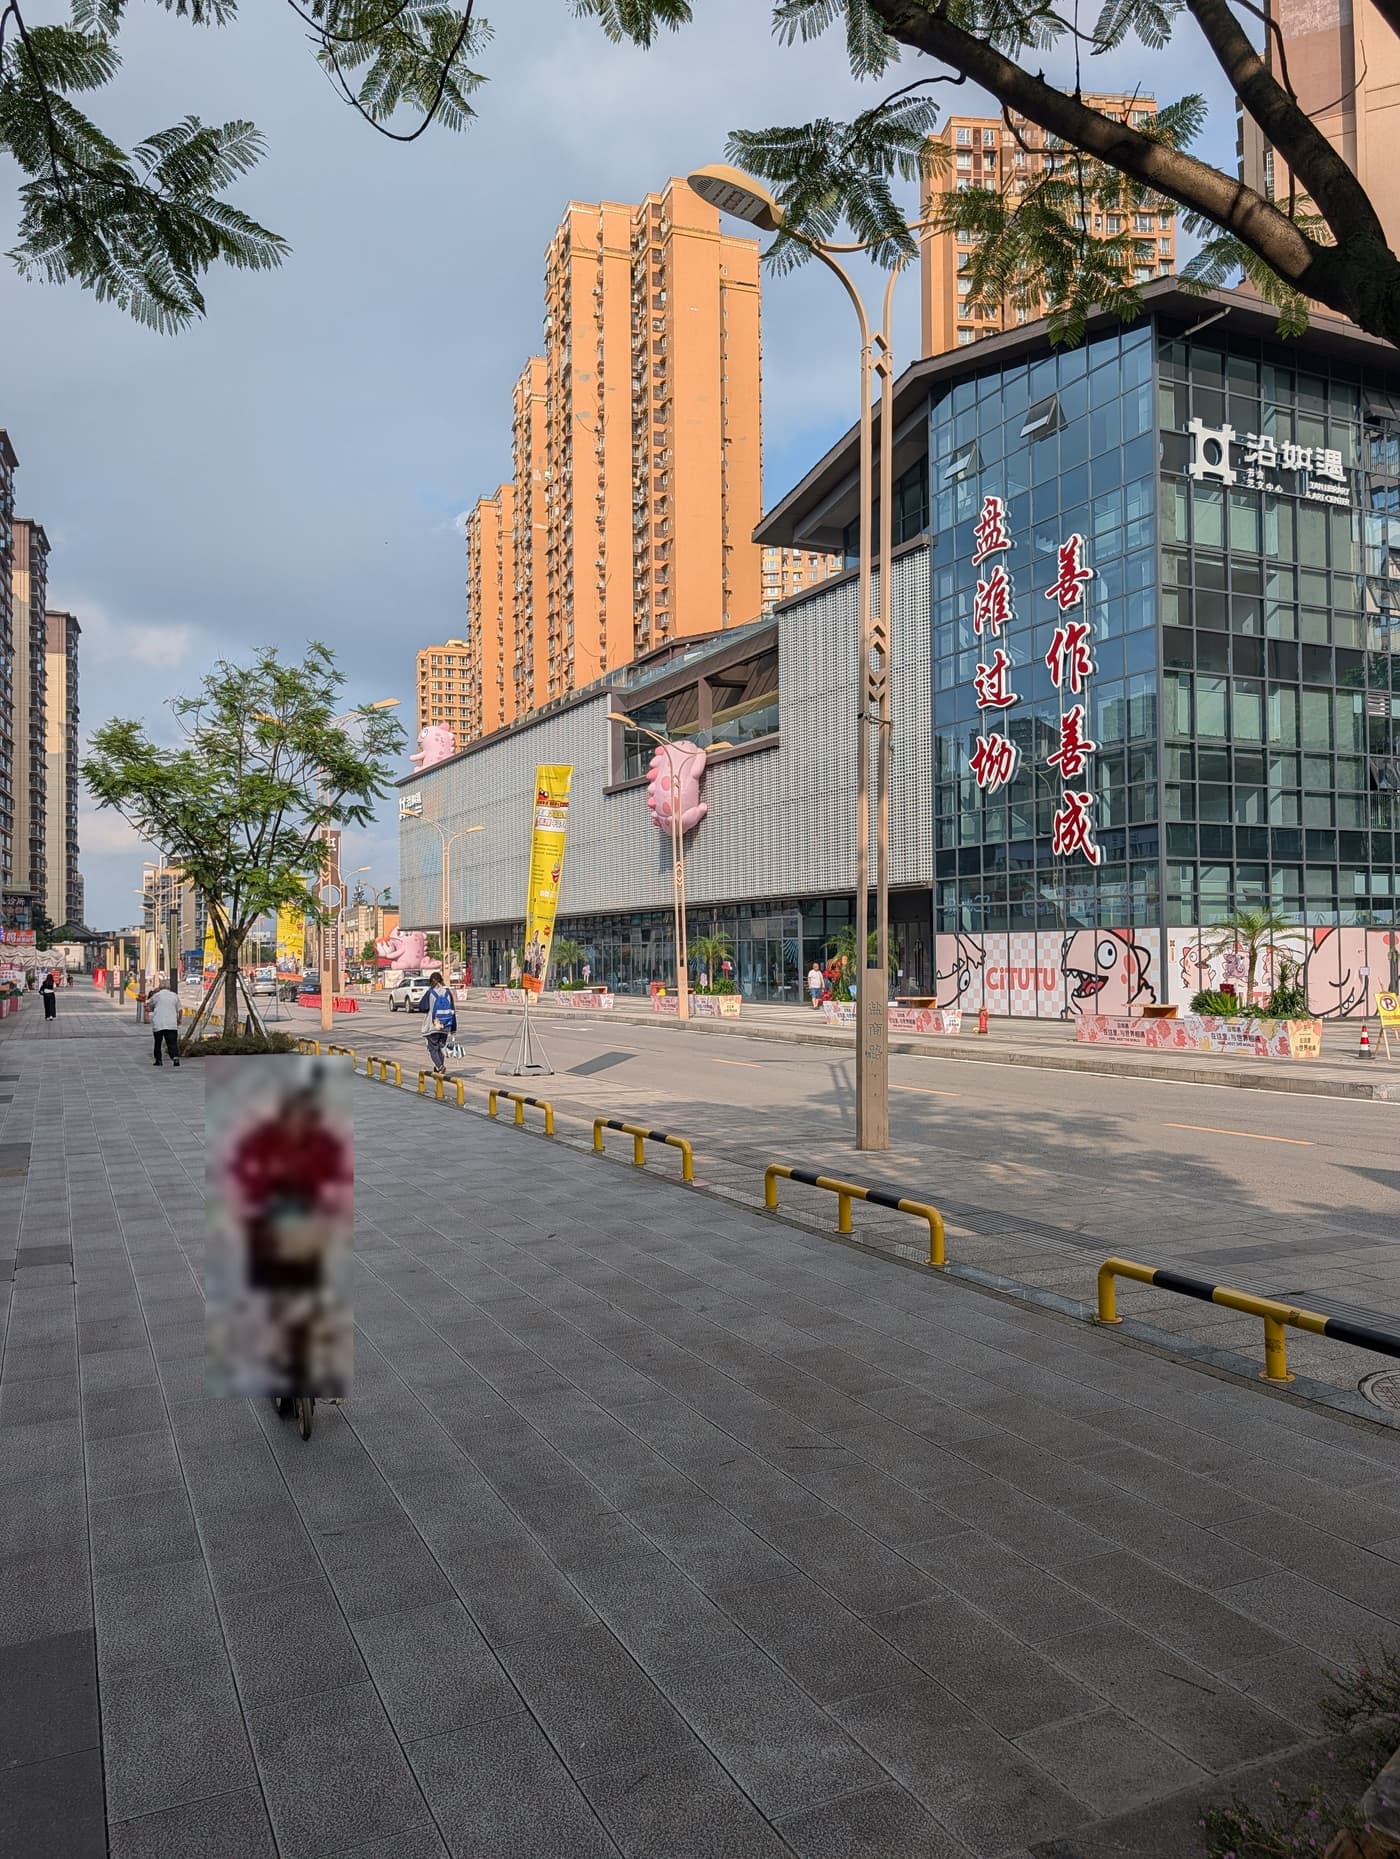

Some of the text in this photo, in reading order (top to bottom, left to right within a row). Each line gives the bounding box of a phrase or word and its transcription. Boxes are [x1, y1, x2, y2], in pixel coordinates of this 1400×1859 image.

[1247, 479, 1284, 493] 艺文中心
[970, 496, 1019, 793] 盘滩过坳
[1045, 533, 1100, 866] 善作善成
